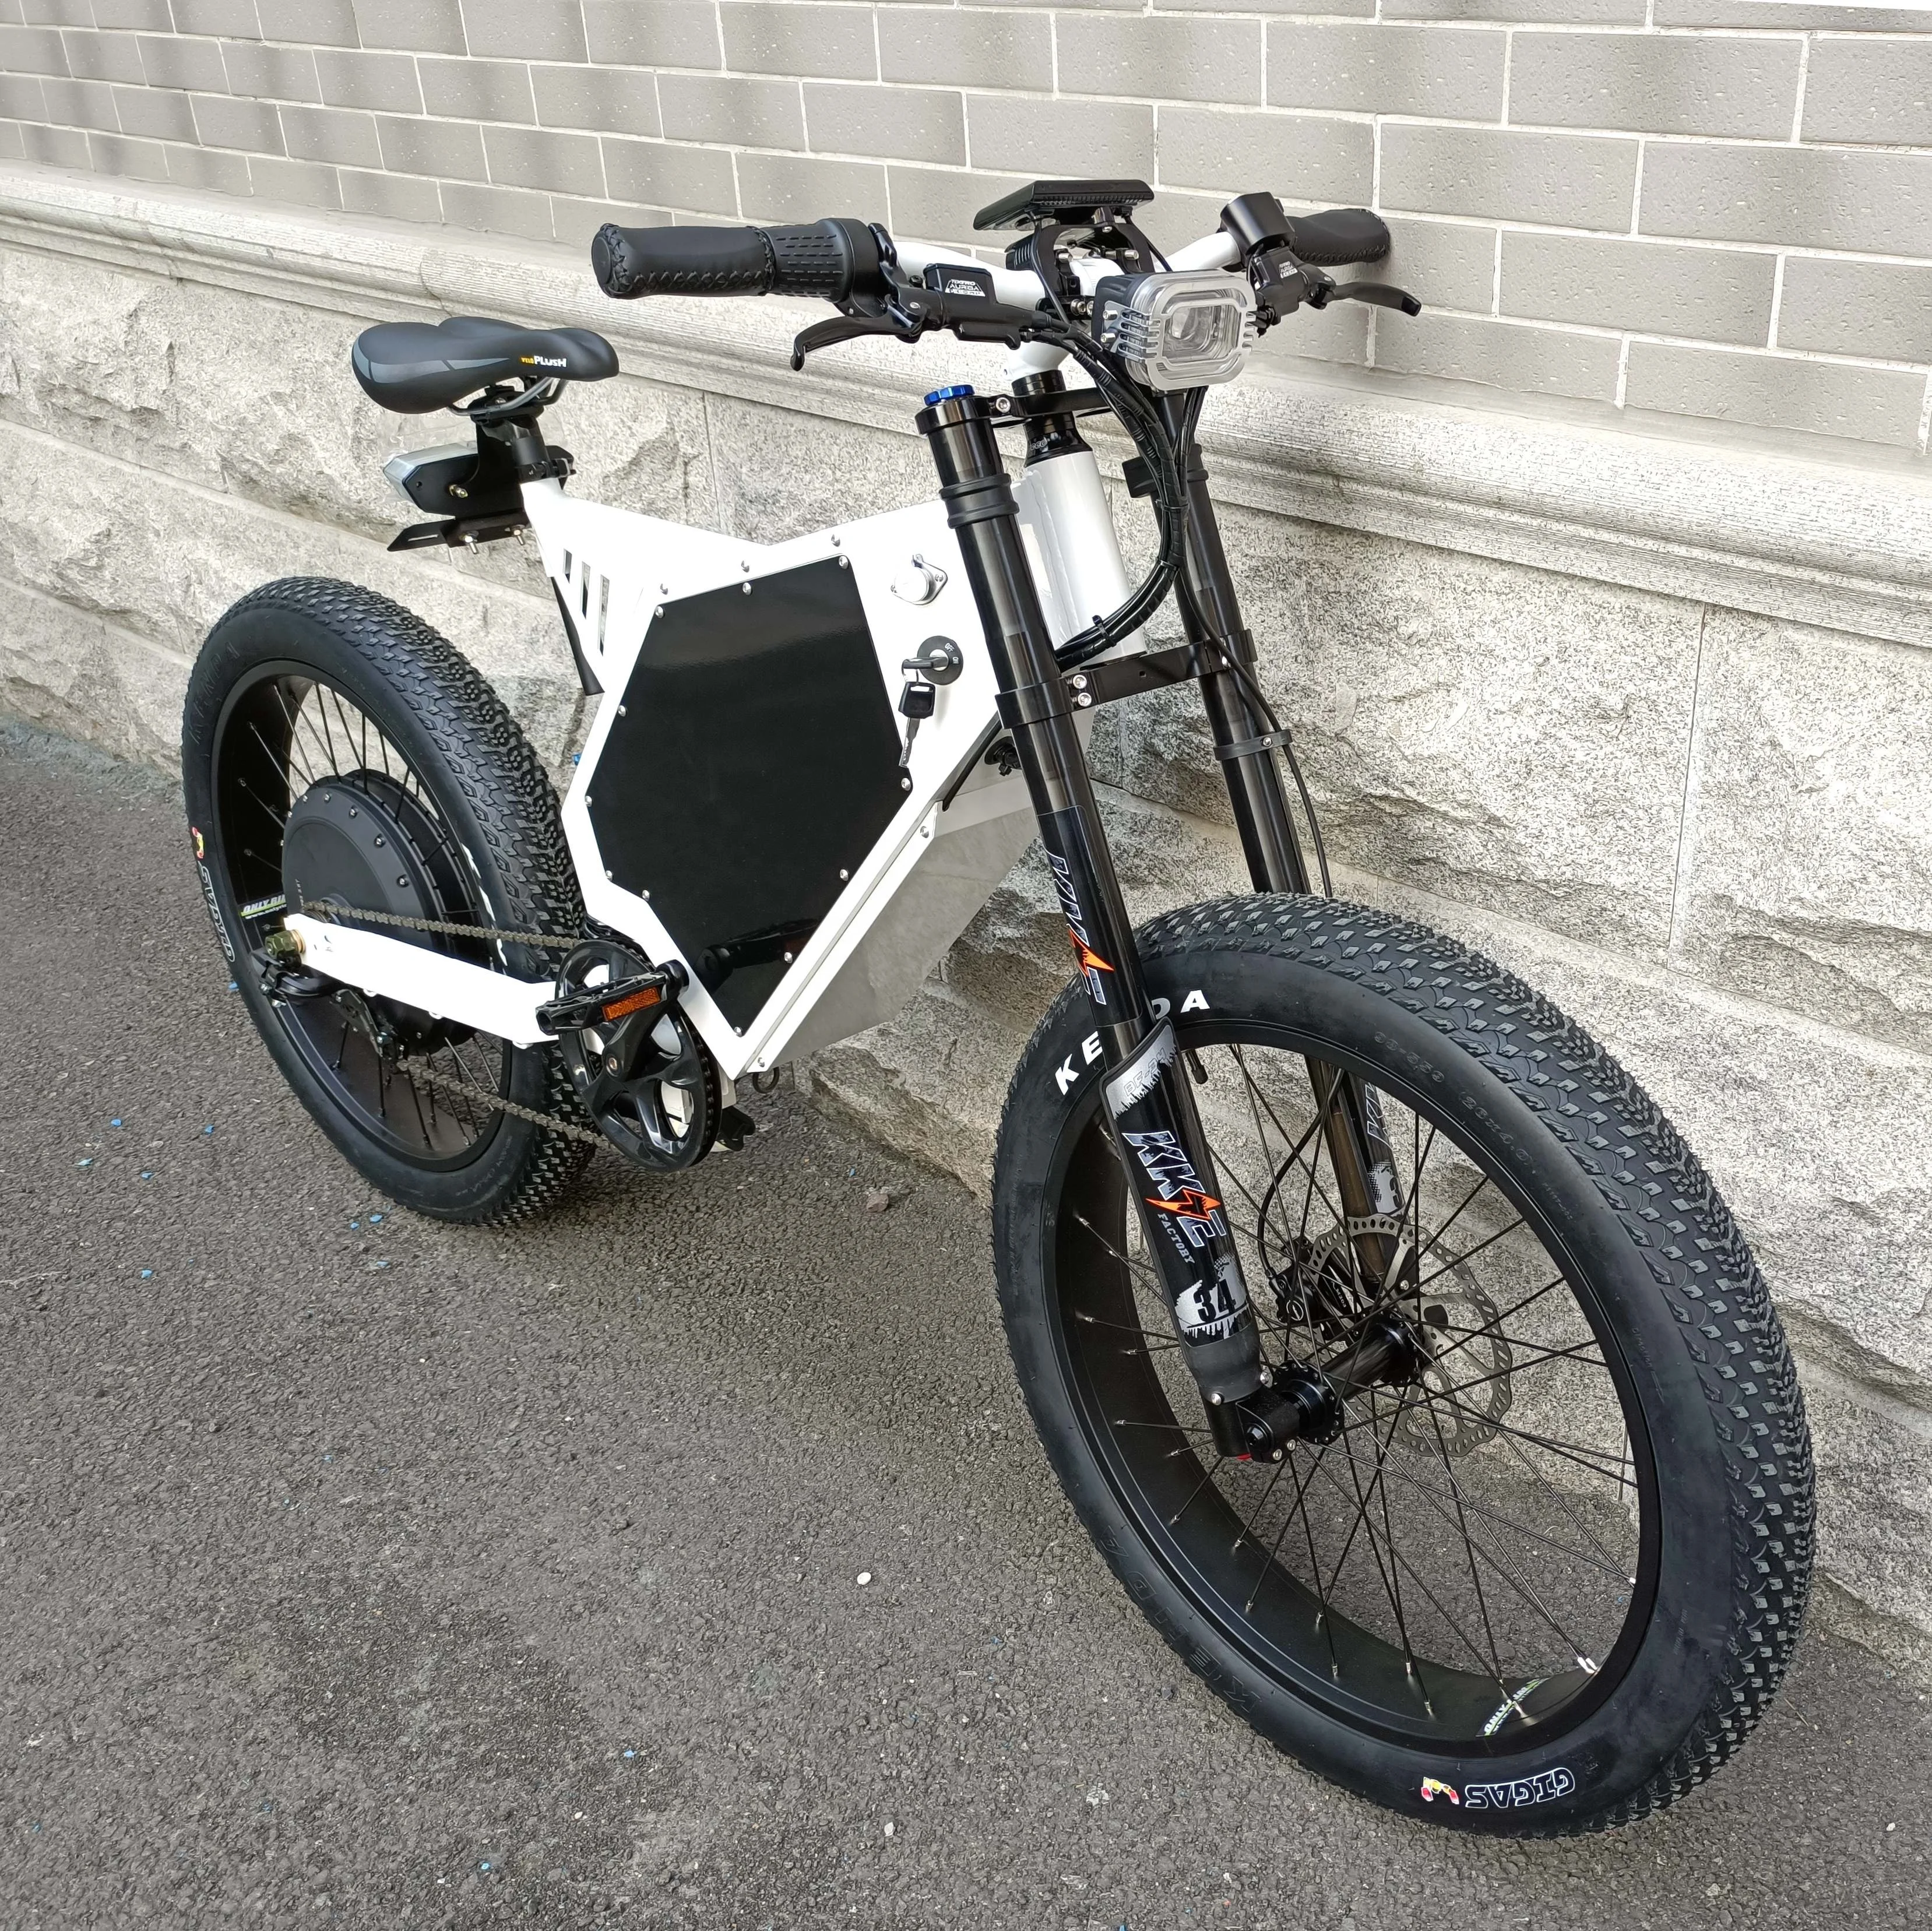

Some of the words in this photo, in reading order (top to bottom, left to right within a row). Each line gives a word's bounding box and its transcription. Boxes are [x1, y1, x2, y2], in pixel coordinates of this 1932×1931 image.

[945, 642, 955, 652] OFF
[1055, 989, 1210, 1096] KEDA
[1157, 1213, 1195, 1264] FACTORY
[1193, 1278, 1237, 1323] 34
[1465, 1767, 1575, 1809] GIGAS
